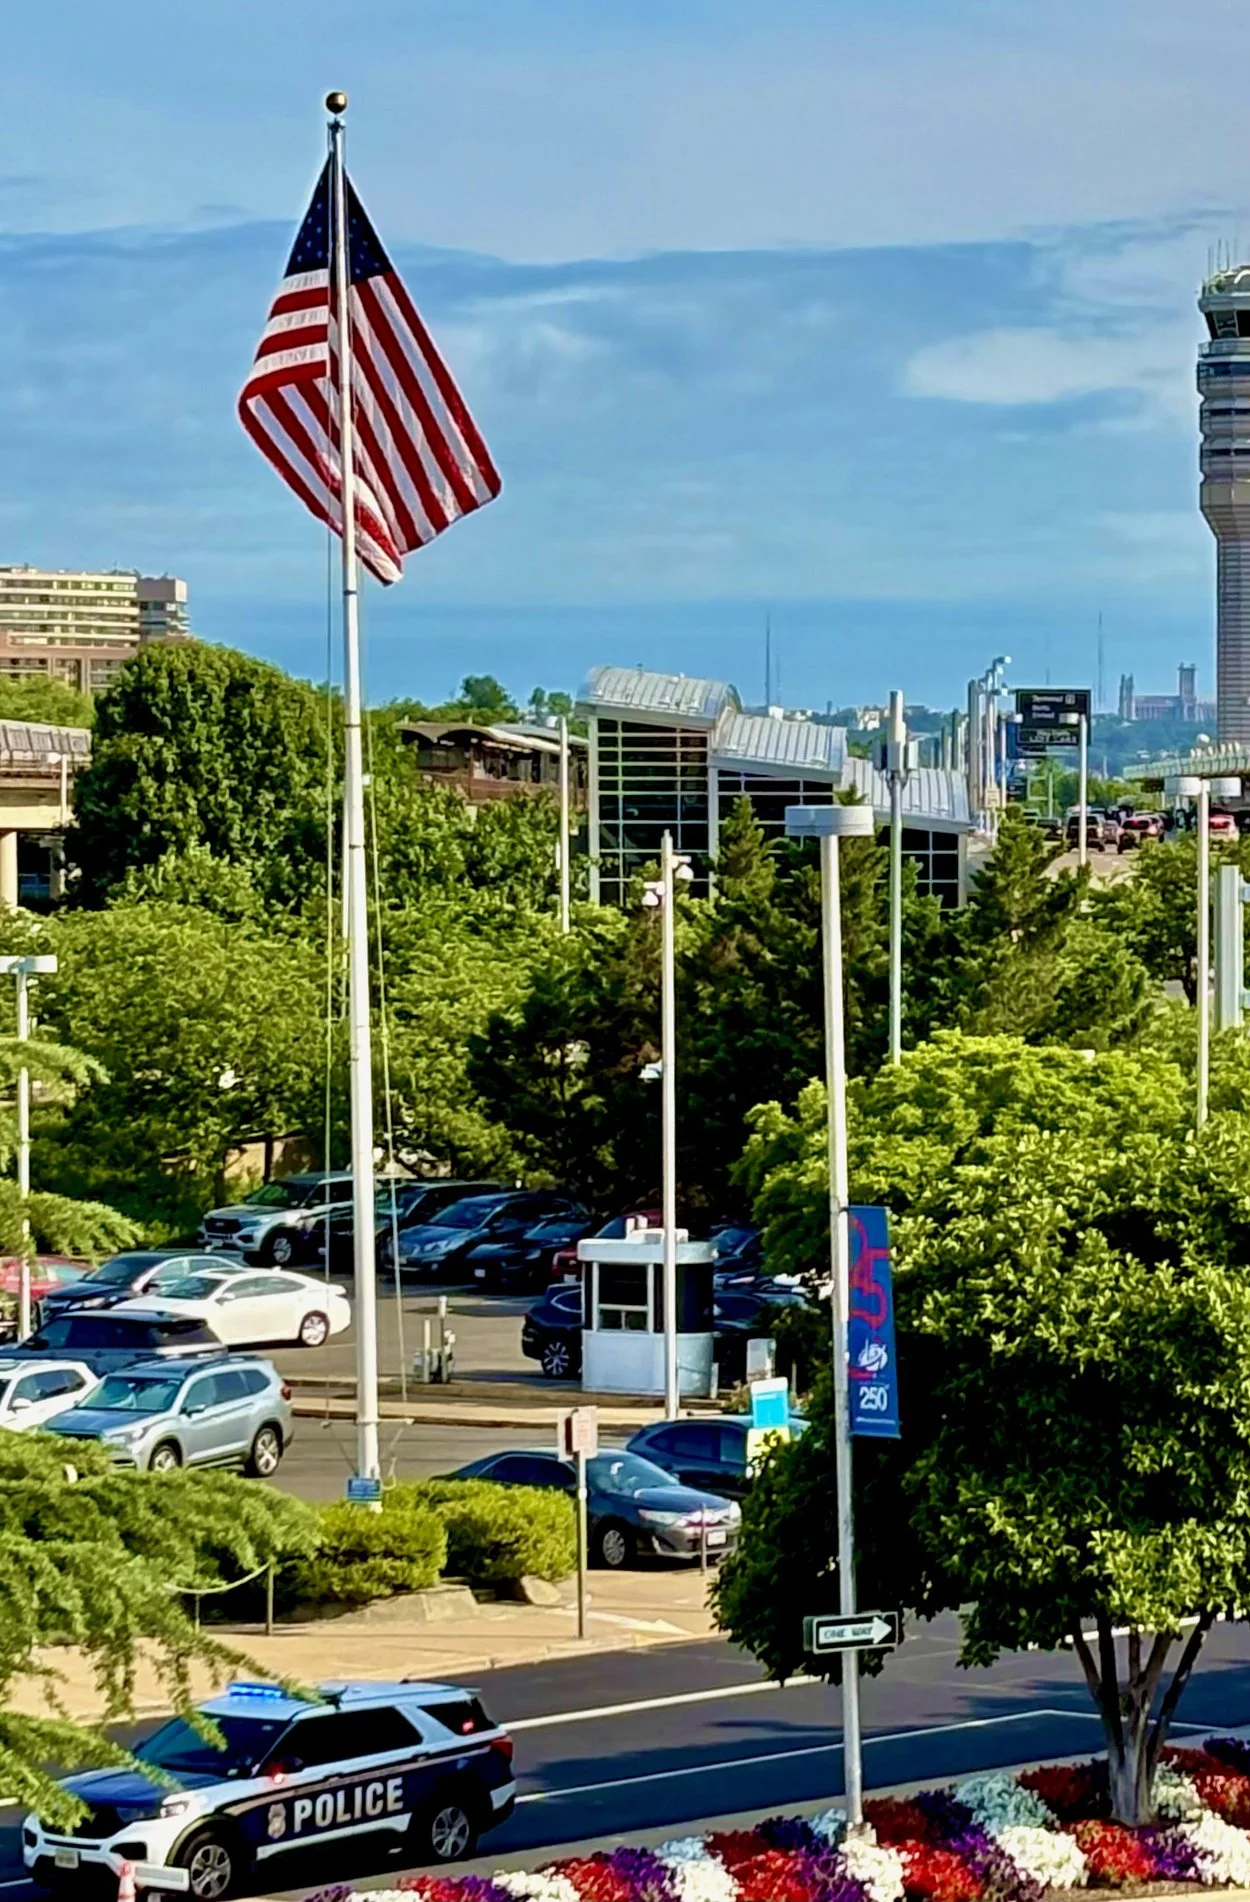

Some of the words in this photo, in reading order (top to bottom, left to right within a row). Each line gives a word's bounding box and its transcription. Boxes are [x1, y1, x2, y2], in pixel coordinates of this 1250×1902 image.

[859, 1385, 888, 1412] 250
[823, 1628, 846, 1640] ONE
[852, 1626, 873, 1637] WAY
[293, 1776, 404, 1833] POLICE
